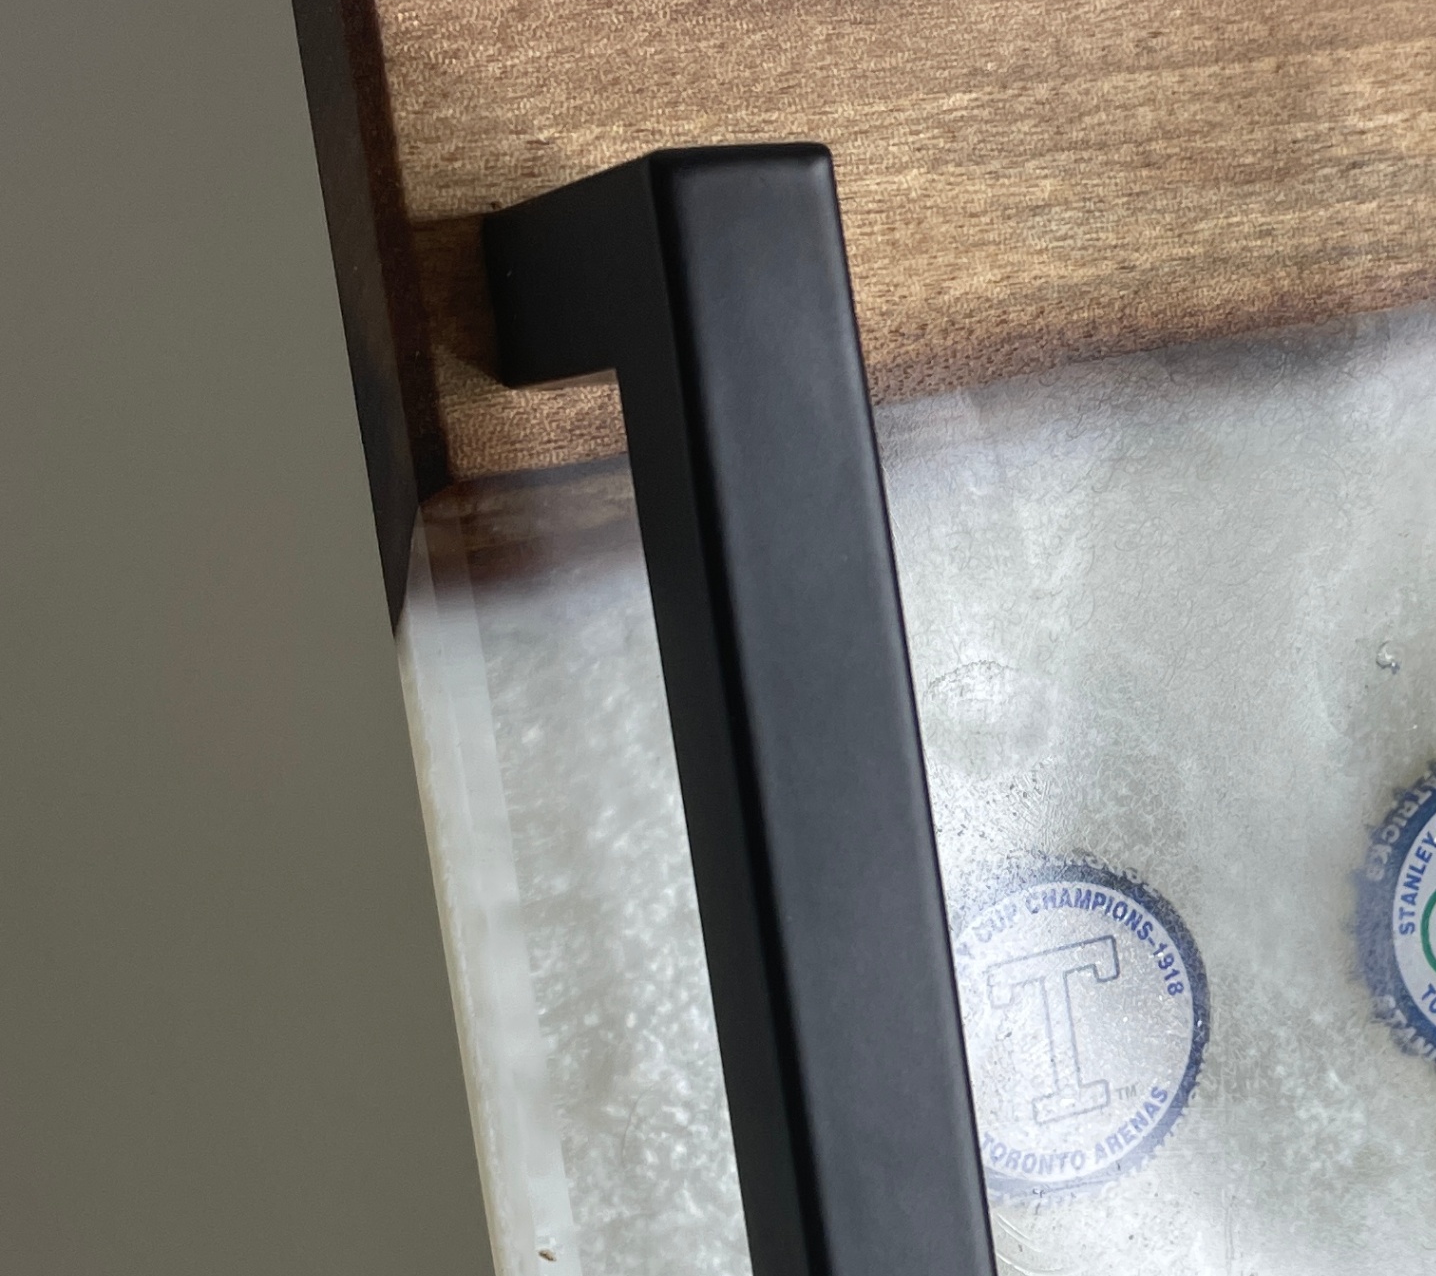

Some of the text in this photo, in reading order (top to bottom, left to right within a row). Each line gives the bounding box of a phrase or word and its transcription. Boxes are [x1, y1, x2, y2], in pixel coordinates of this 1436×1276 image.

[1023, 886, 1185, 997] CHAMPIONS-1918
[986, 934, 1121, 1126] T
[980, 1084, 1168, 1176] TORONTO ARENAS
